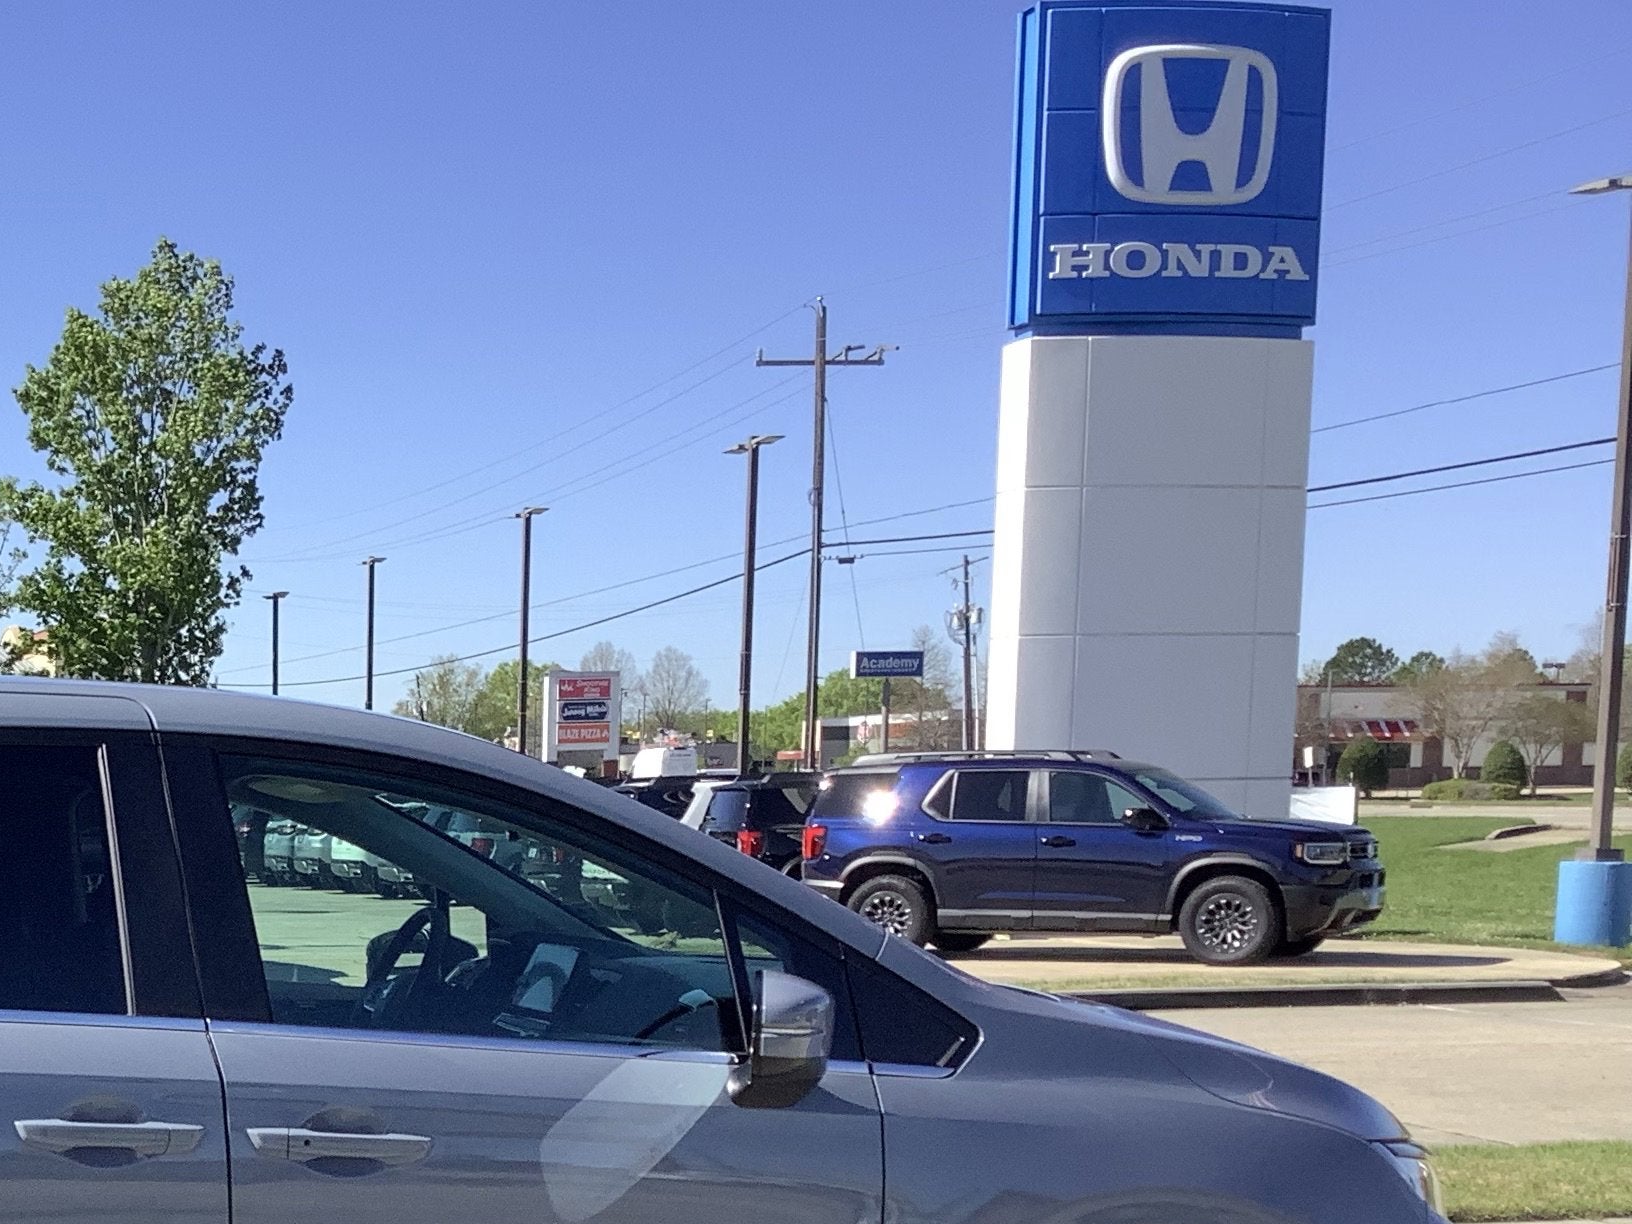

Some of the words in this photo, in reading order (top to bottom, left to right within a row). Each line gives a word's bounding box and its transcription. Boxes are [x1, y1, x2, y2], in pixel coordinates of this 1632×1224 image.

[1049, 242, 1309, 280] HONDA
[860, 657, 919, 671] Academy
[558, 728, 579, 738] BLAZE
[580, 728, 601, 738] PIZZA
